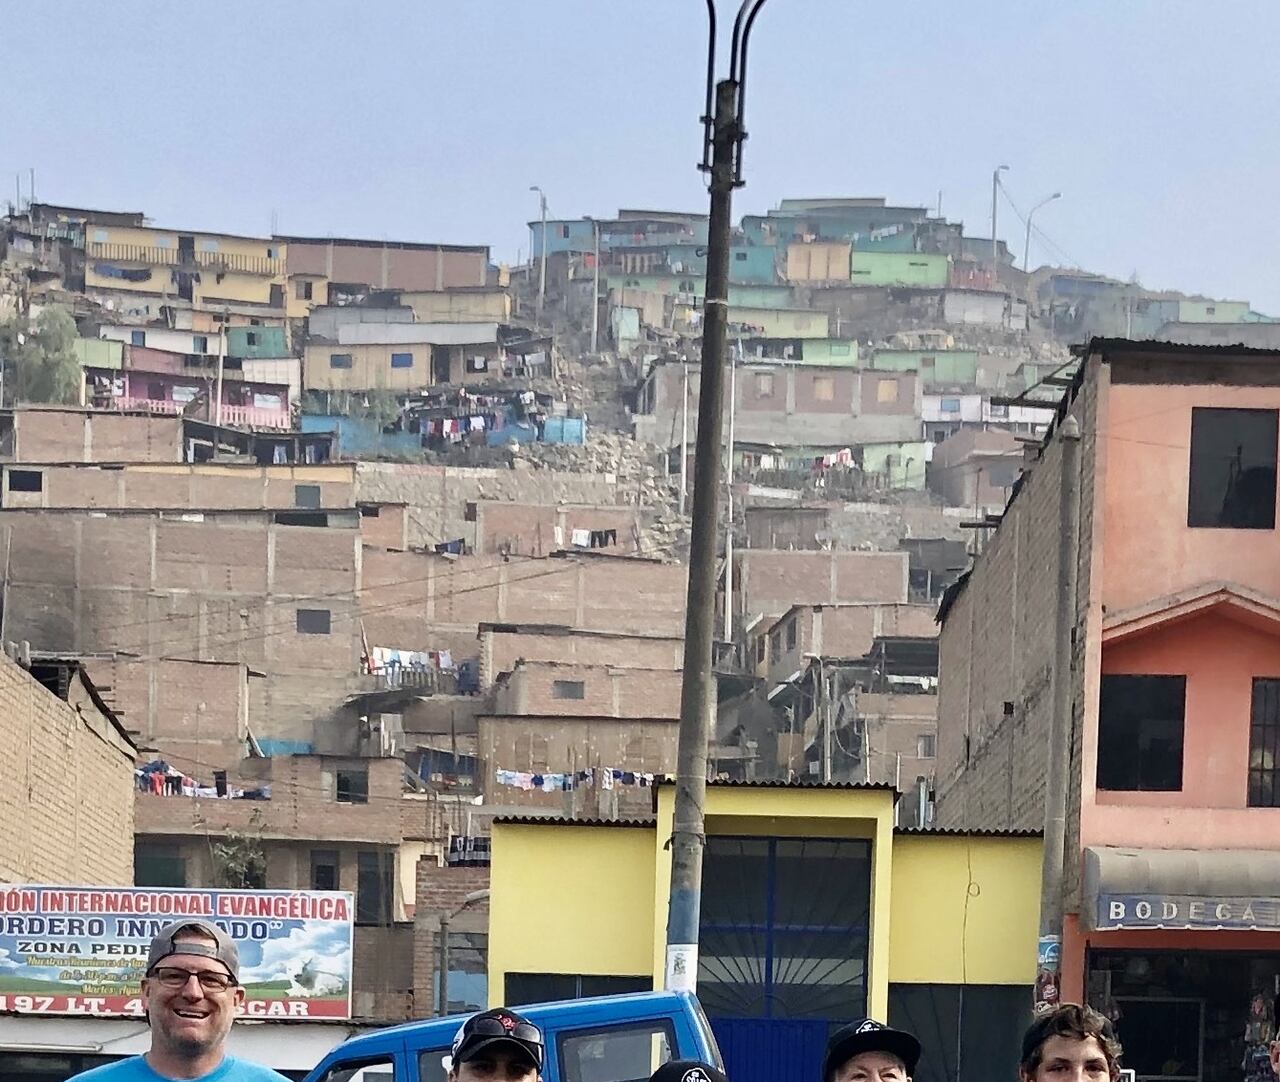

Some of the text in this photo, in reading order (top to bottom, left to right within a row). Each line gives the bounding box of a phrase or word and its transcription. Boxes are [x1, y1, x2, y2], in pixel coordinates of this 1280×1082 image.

[41, 891, 212, 916] INTERNACIONAL
[219, 893, 348, 920] EVANGÉLICA
[1109, 901, 1256, 922] BODEGA
[18, 941, 81, 954] ZONA
[67, 997, 111, 1014] LT.
